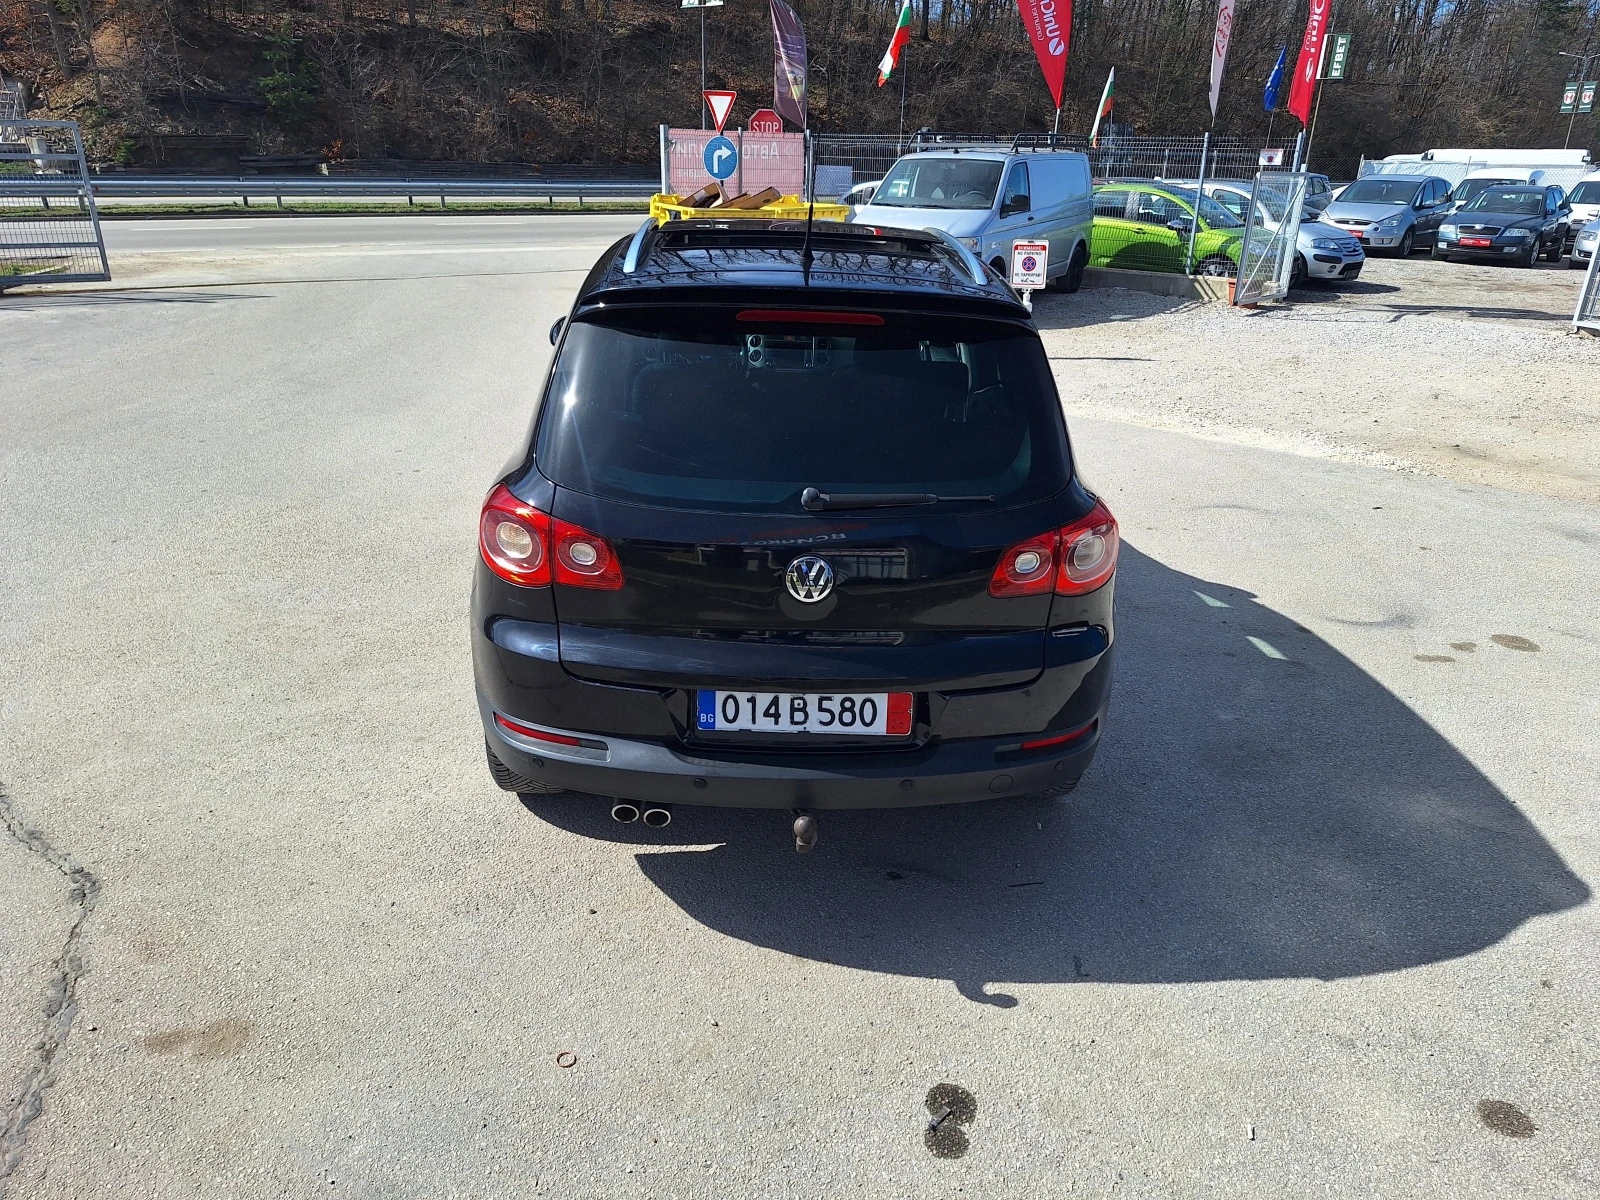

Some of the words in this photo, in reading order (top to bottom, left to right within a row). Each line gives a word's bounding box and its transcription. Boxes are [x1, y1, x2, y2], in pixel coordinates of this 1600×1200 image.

[1331, 36, 1347, 77] EFBET
[752, 120, 779, 133] STOP
[700, 713, 714, 723] BG
